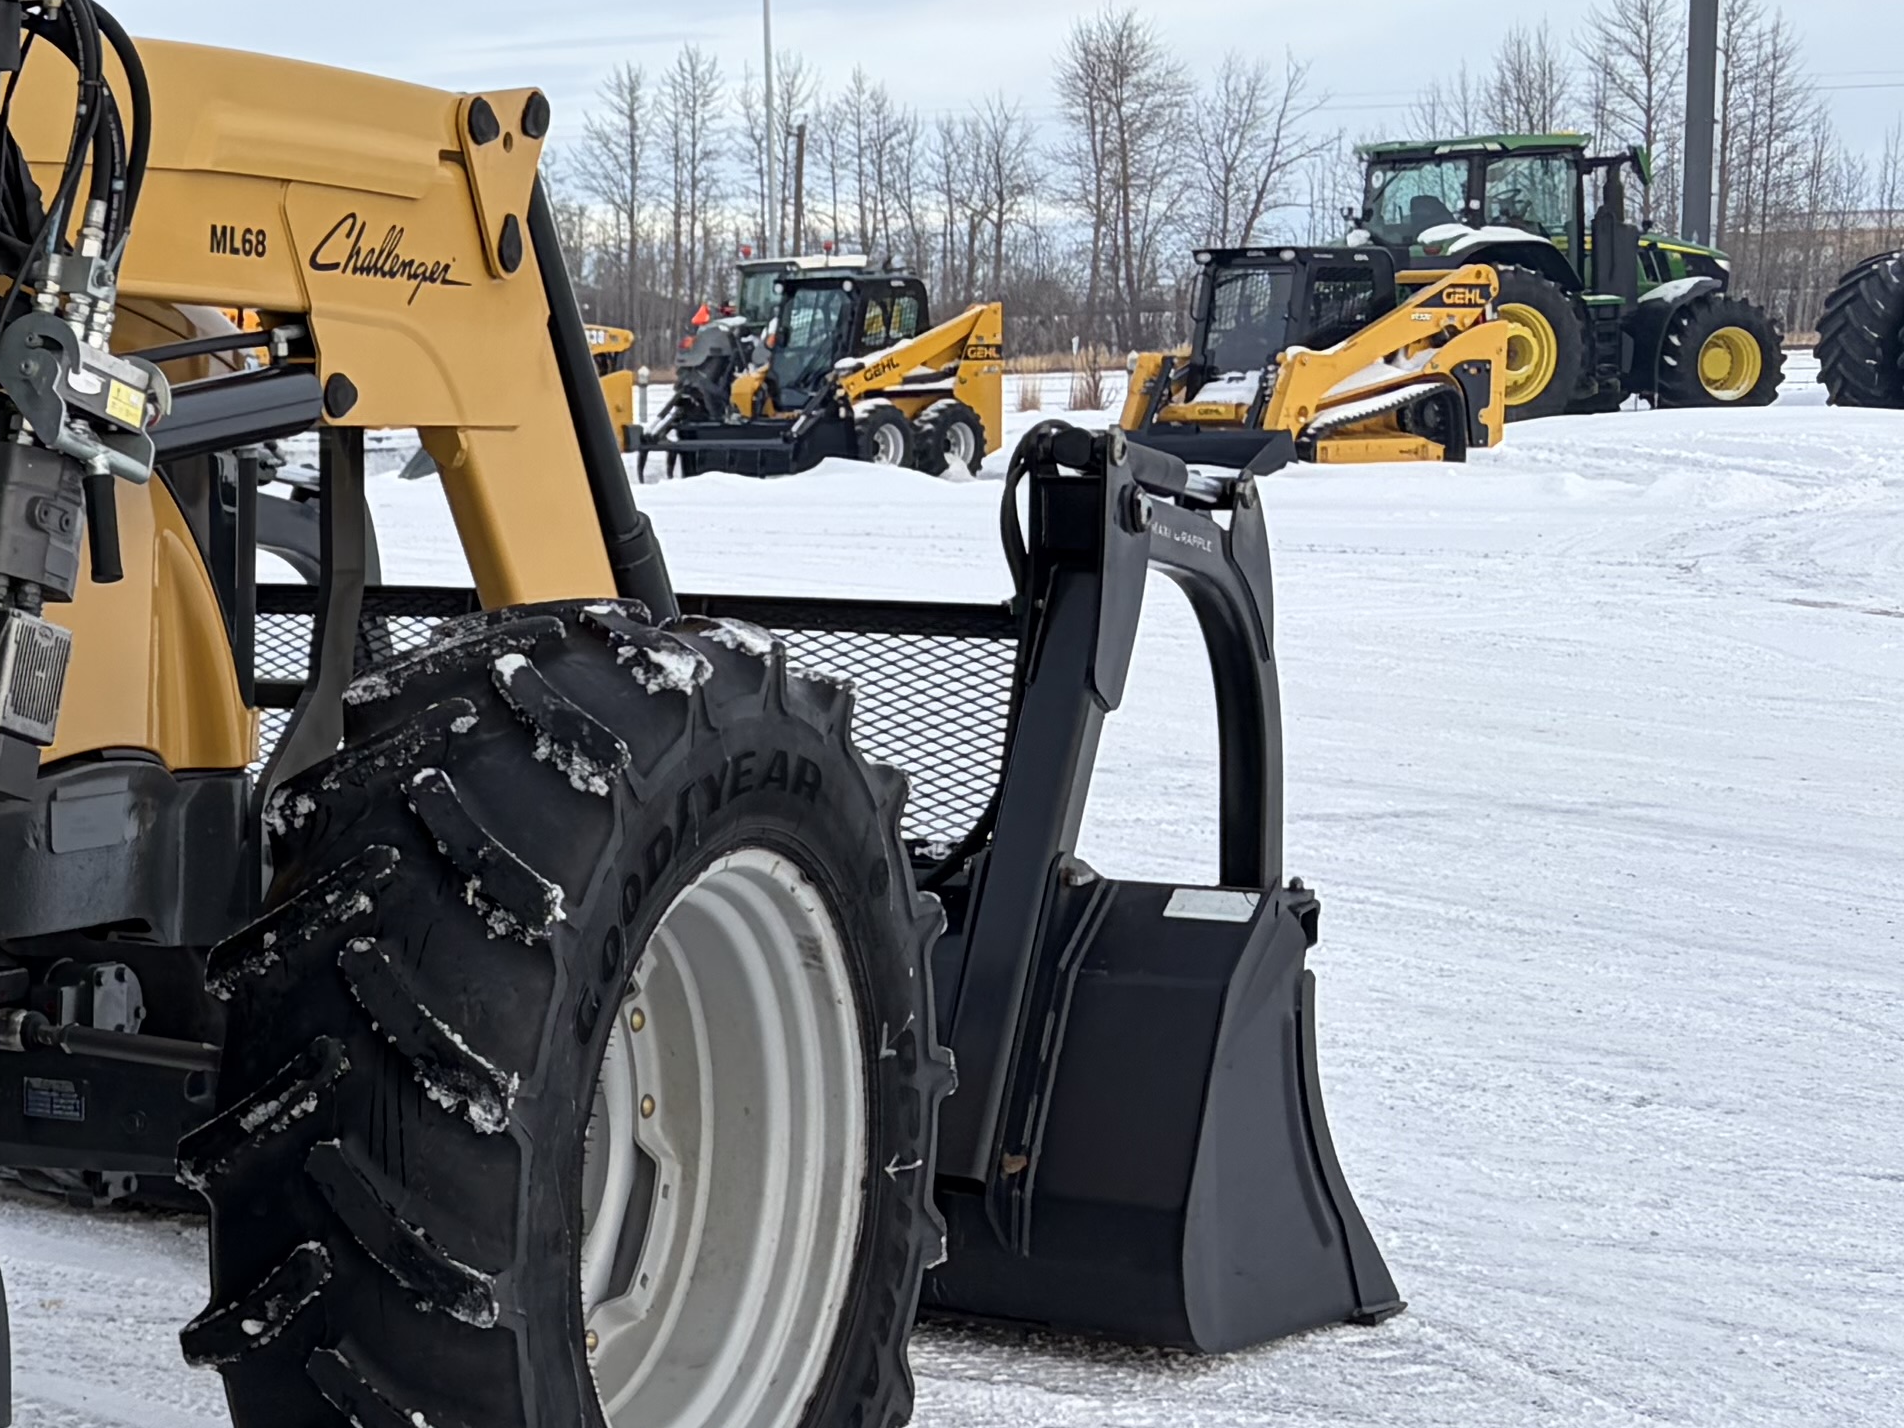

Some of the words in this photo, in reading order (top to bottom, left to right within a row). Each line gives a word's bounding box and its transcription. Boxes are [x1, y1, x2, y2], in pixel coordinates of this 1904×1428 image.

[209, 224, 267, 258] ML68
[308, 212, 472, 306] Challenger
[1442, 287, 1487, 305] GEHL
[966, 346, 1001, 359] GEHL
[863, 357, 900, 382] GEHL
